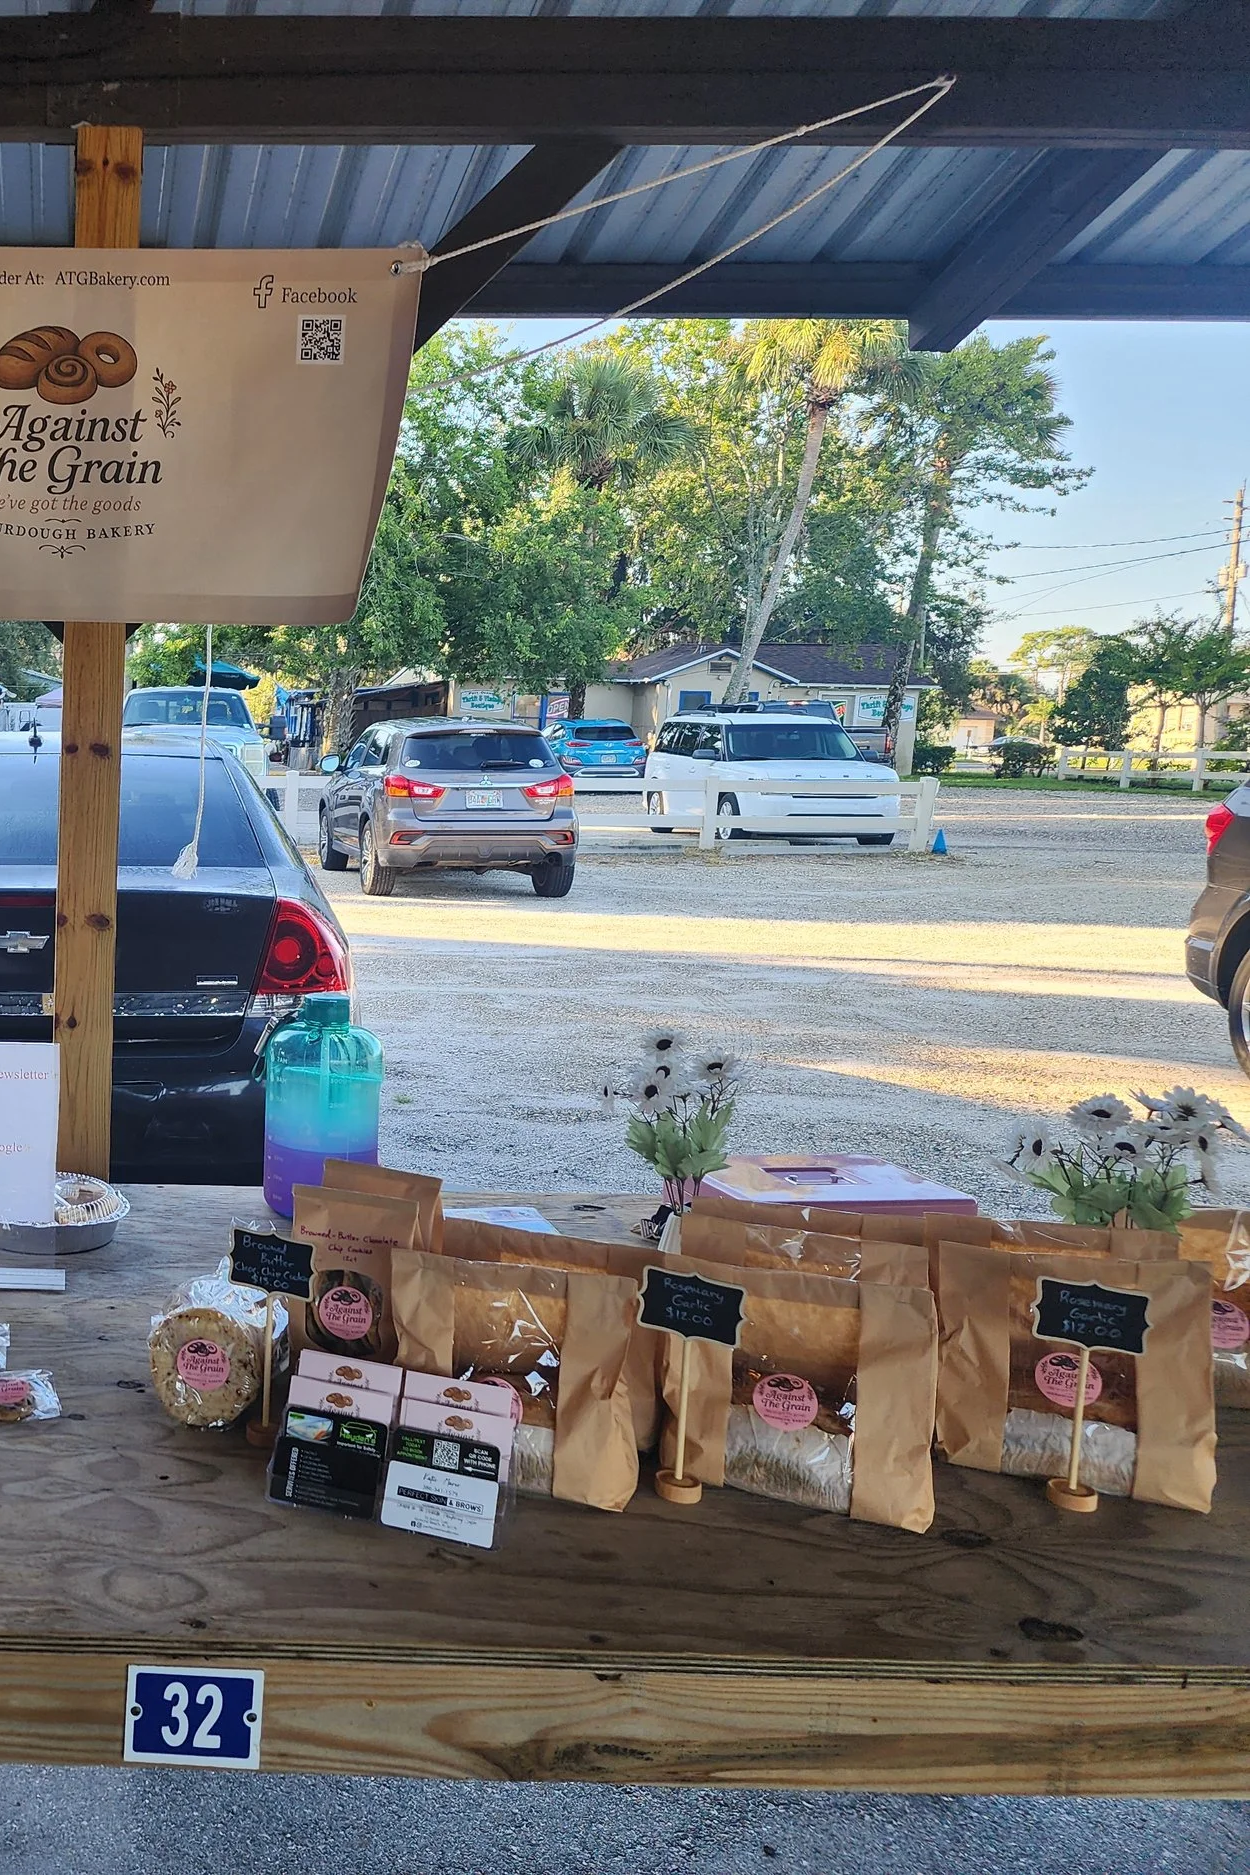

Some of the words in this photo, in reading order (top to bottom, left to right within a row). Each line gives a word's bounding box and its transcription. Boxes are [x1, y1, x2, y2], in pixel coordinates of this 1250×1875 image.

[25, 272, 44, 285] At:
[55, 271, 170, 289] ATGBakery.com
[281, 287, 357, 303] Facebook
[47, 445, 163, 494] Grain
[30, 497, 58, 514] got
[62, 495, 87, 511] the
[92, 496, 142, 515] goods
[87, 523, 155, 540] BAKERY
[548, 701, 569, 713] OPEN
[243, 1235, 287, 1254] Browned
[260, 1252, 295, 1267] Butter
[664, 1278, 725, 1305] Rosemary
[329, 1304, 362, 1315] Against
[672, 1294, 711, 1311] Garlic
[1059, 1290, 1127, 1317] Rosemary
[326, 1312, 341, 1321] The
[342, 1312, 367, 1324] Grain
[665, 1306, 715, 1327] $12.00
[1070, 1307, 1117, 1325] Garlic
[1061, 1319, 1122, 1338] $12.00
[1044, 1376, 1063, 1386] The
[761, 1398, 780, 1408] The
[781, 1400, 811, 1412] Grain
[765, 1390, 805, 1402] Against
[290, 1447, 299, 1471] OFFERED
[478, 1460, 496, 1469] PHONE
[285, 1471, 296, 1497] SERVICES
[398, 1487, 429, 1500] PERFECT
[430, 1495, 447, 1505] SKIN
[455, 1501, 482, 1513] BROWS
[161, 1681, 224, 1749] 32
